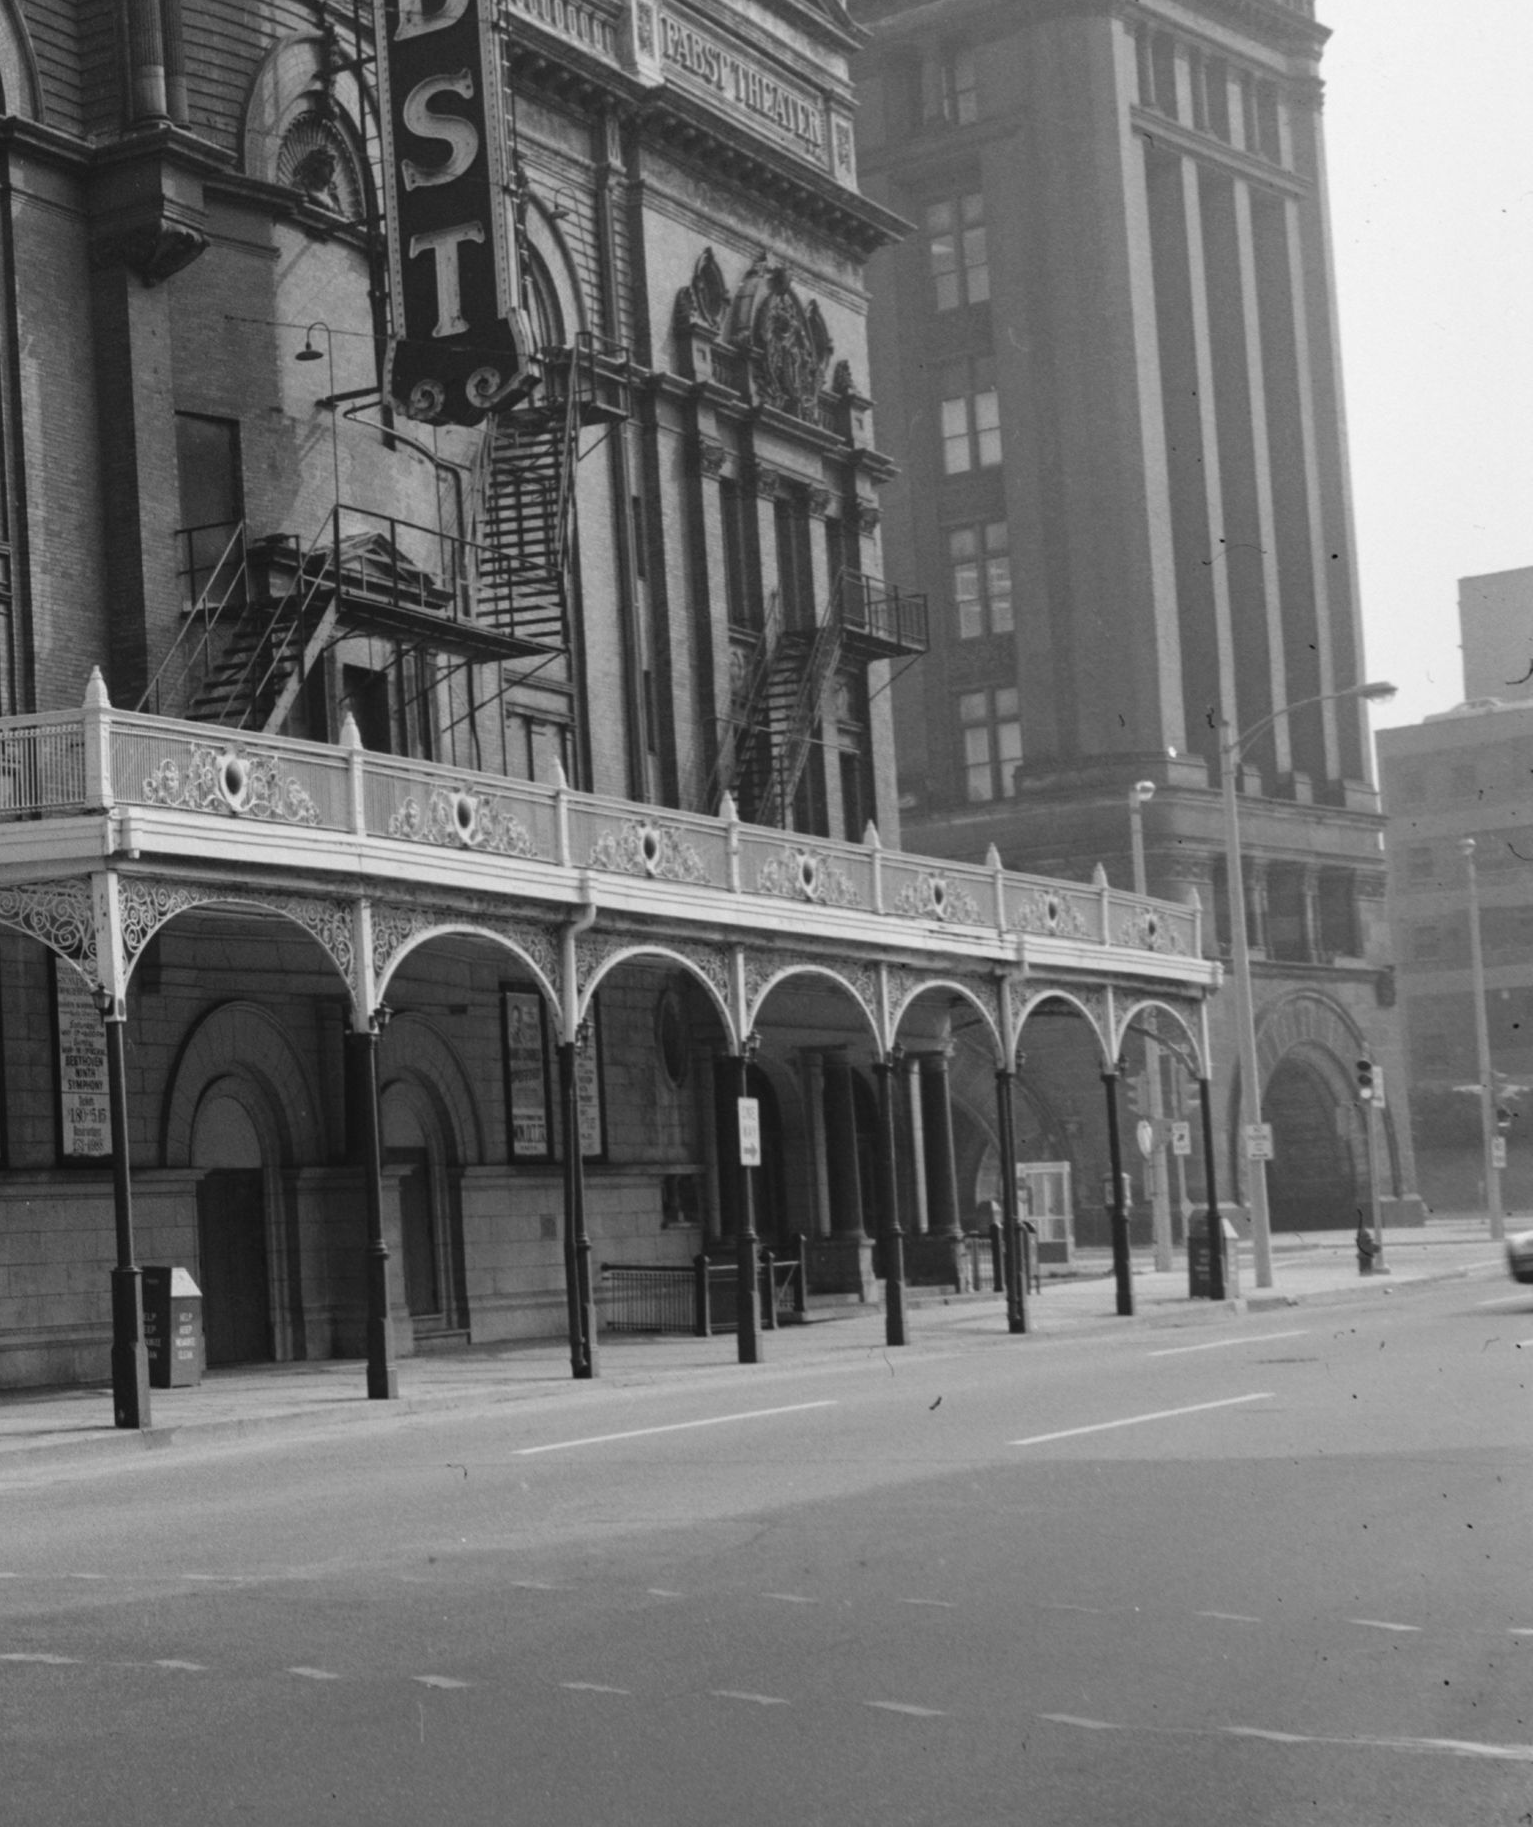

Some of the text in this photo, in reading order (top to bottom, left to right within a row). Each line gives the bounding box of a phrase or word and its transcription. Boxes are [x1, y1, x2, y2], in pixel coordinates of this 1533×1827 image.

[660, 17, 821, 149] PABST THEATER
[65, 1055, 103, 1068] BEETHOVEN
[68, 1079, 103, 1091] SYMPHONY
